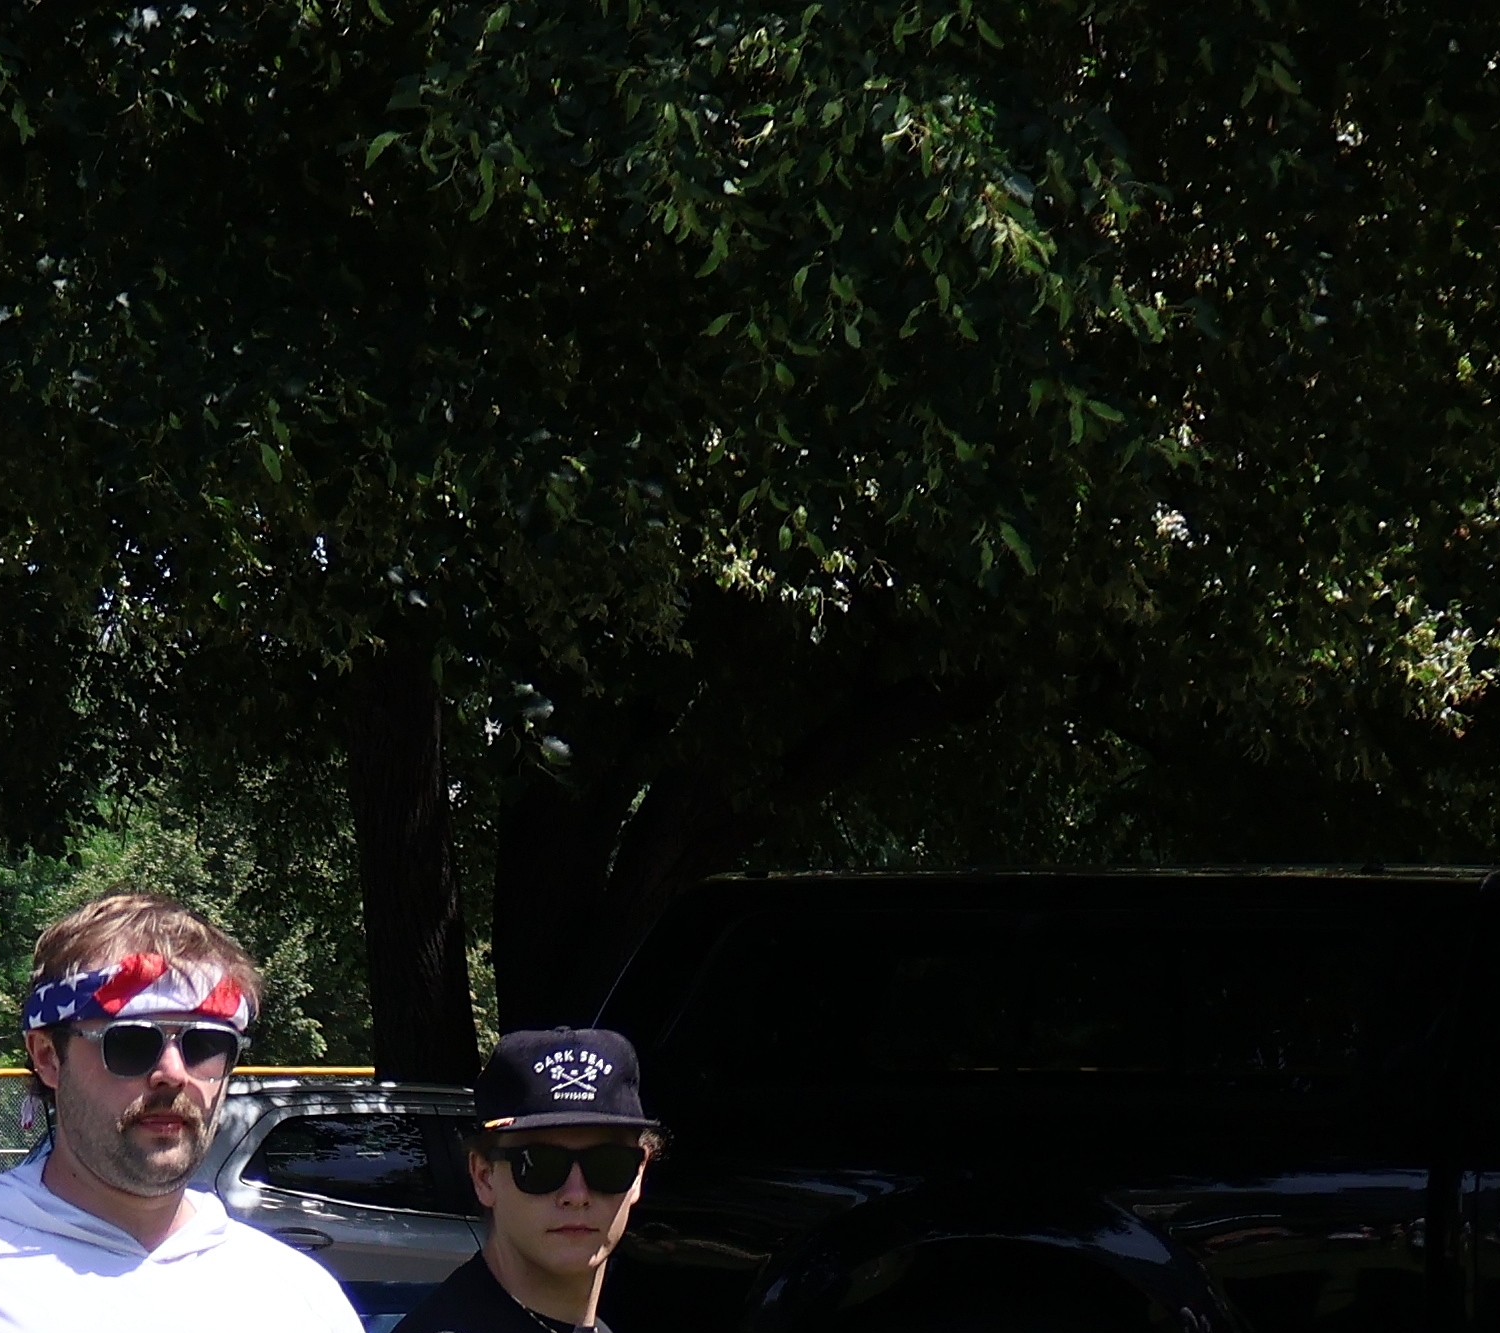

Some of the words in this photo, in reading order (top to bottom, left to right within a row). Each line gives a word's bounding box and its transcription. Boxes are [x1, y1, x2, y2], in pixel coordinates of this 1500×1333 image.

[533, 1049, 575, 1074] DARK
[580, 1050, 613, 1075] SEAS
[553, 1091, 595, 1100] DIVISION
